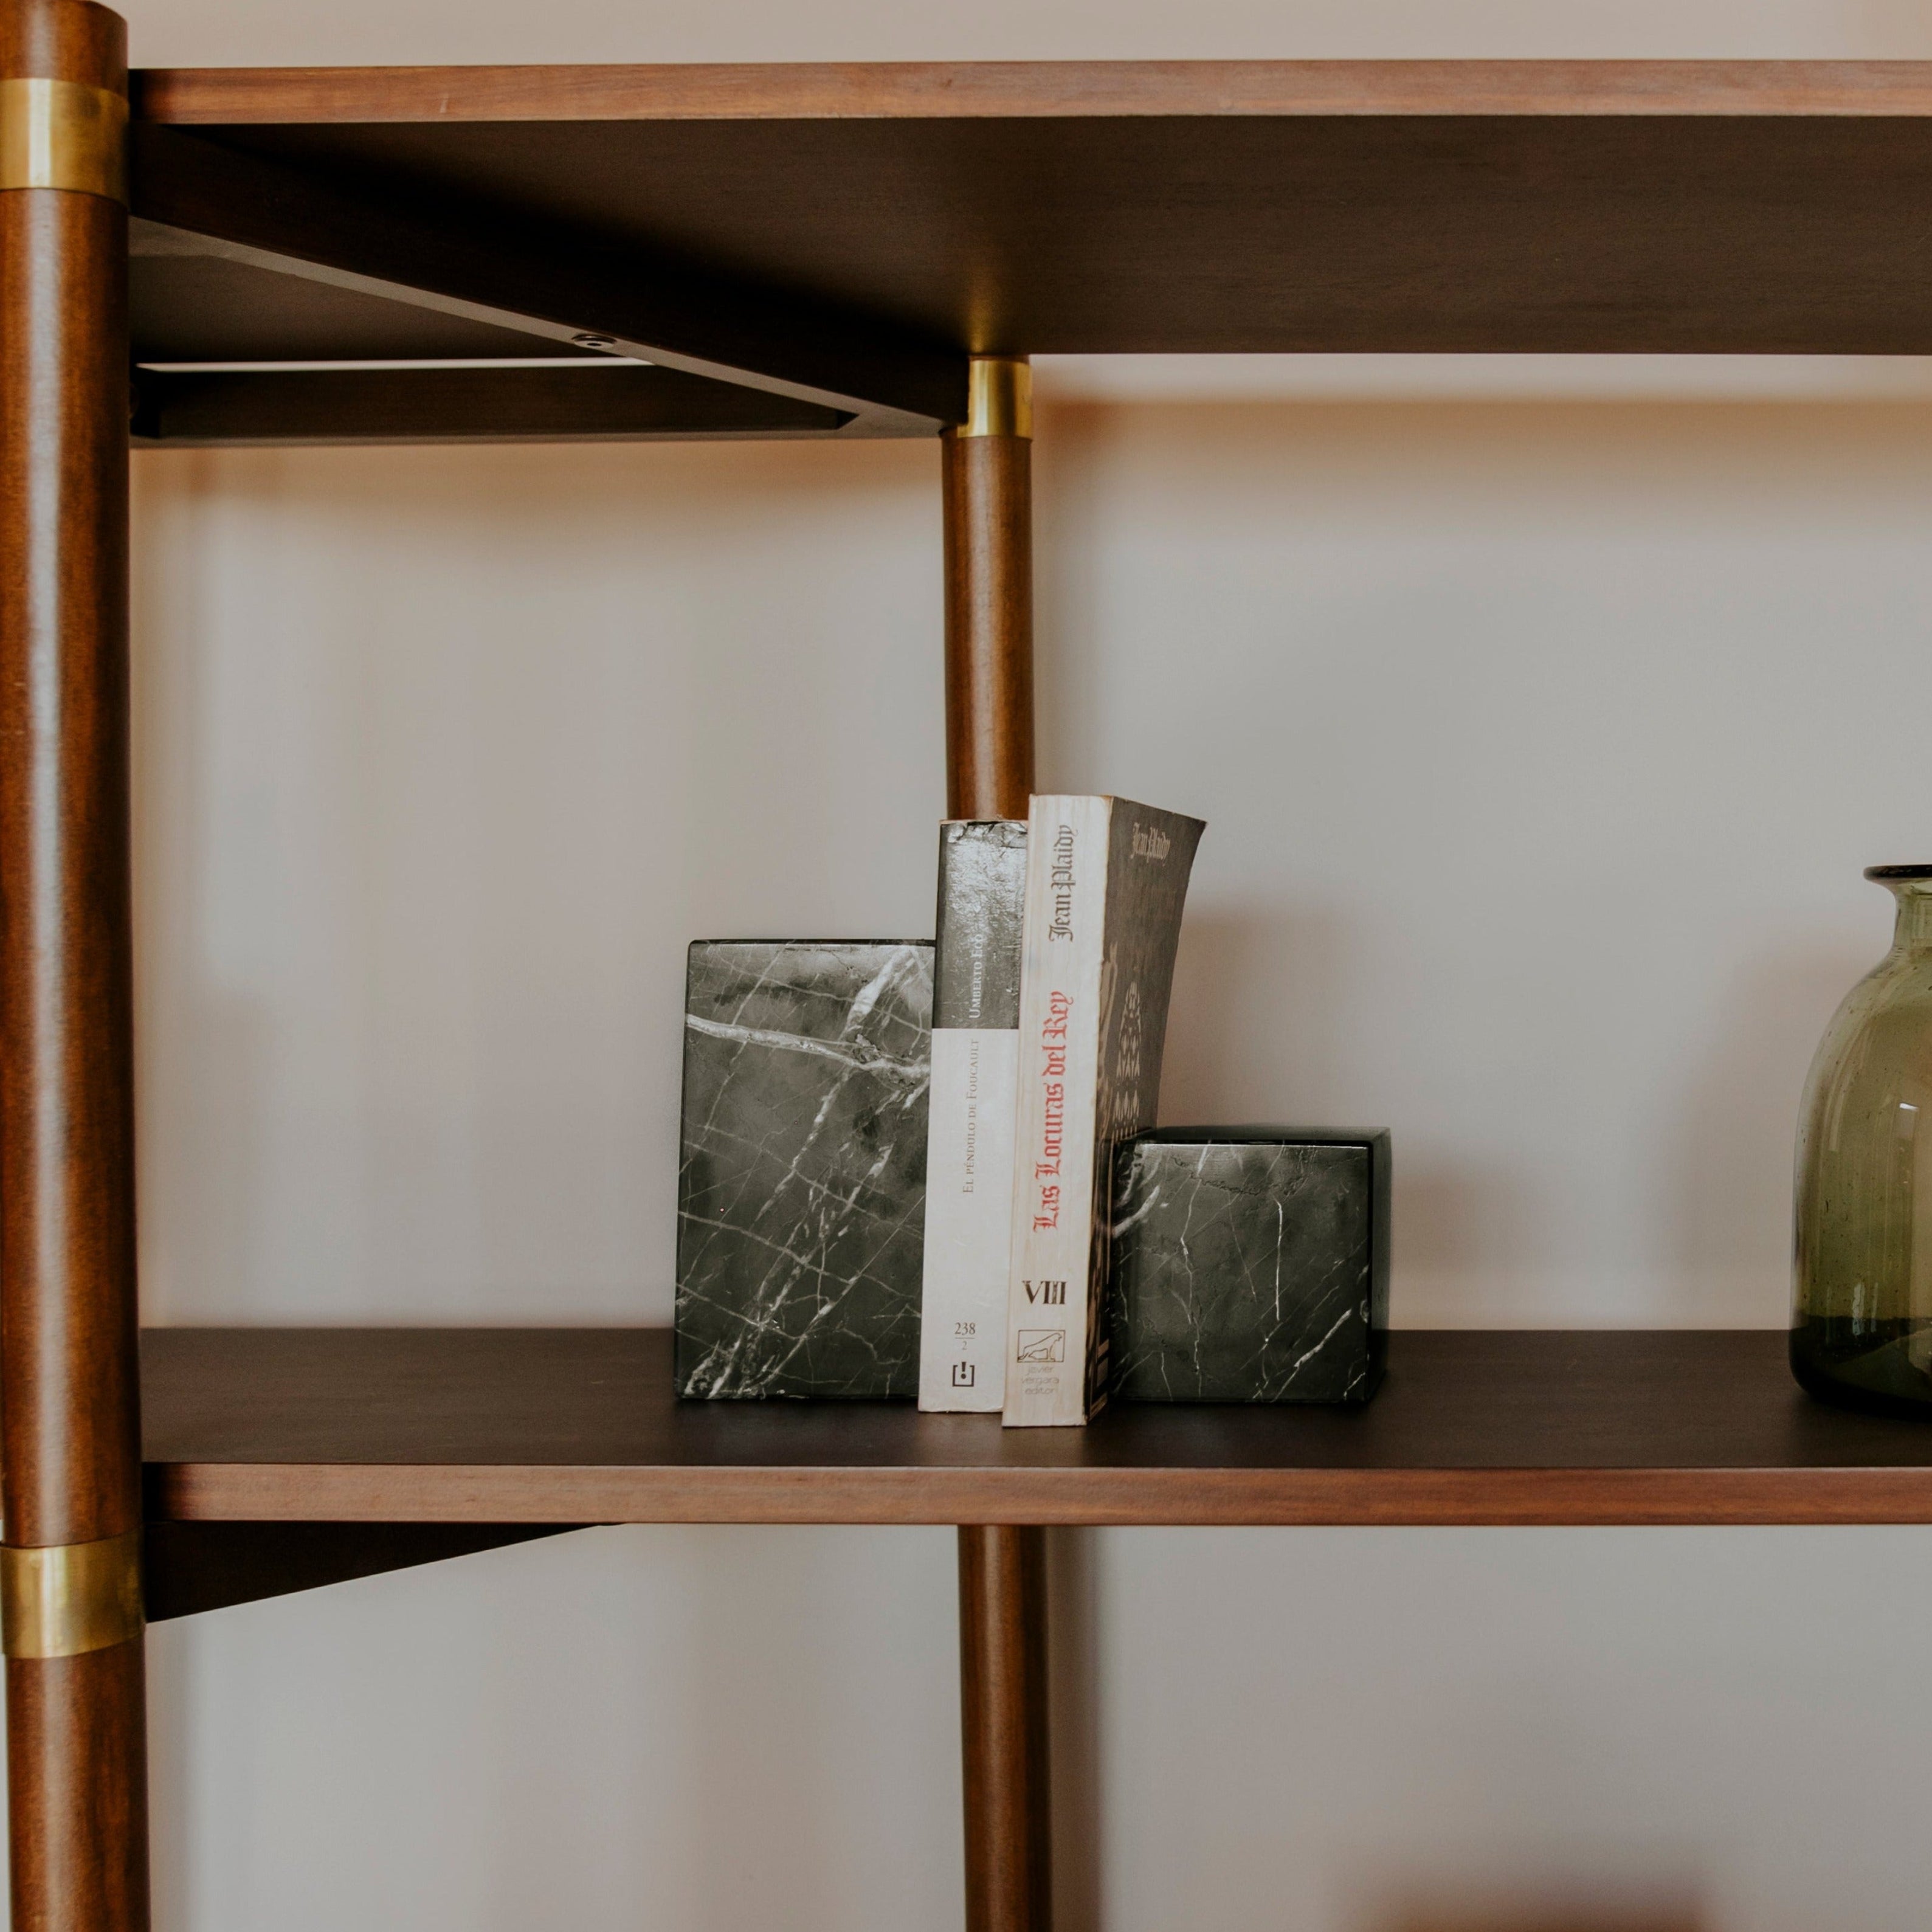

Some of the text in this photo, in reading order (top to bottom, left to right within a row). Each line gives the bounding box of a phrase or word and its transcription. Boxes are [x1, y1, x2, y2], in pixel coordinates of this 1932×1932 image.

[1049, 824, 1078, 942] Jean Plaidy
[969, 933, 984, 1019] UMBERTO ECO
[966, 1038, 979, 1100] FOUCAULT
[968, 1103, 976, 1118] DE
[1033, 990, 1074, 1233] Las Locuras del Rey
[962, 1179, 974, 1193] EL
[1022, 1280, 1067, 1305] VIII
[954, 1322, 976, 1336] 238
[961, 1340, 968, 1350] 2
